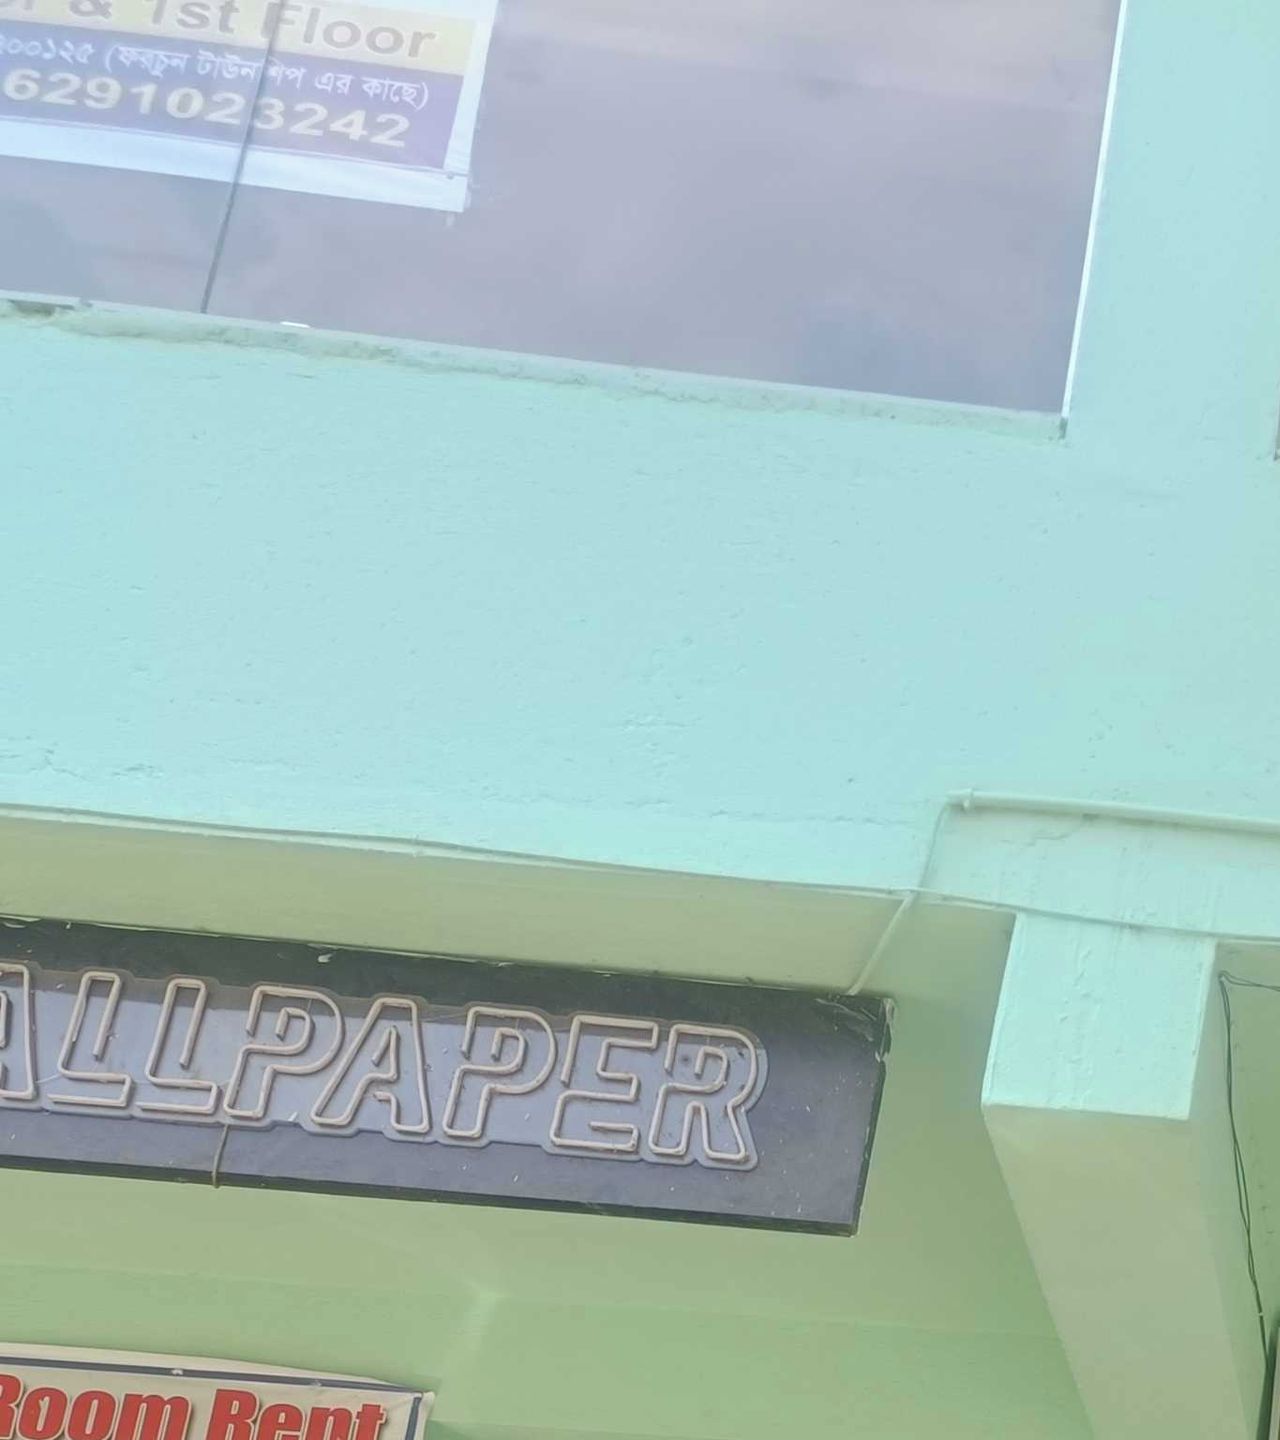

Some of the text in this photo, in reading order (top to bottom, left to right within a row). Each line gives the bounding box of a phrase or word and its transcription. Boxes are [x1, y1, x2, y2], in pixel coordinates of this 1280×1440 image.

[152, 0, 239, 33] 1st
[262, 1, 436, 57] Floor
[3, 67, 411, 147] 6291023242
[313, 72, 355, 96] এর
